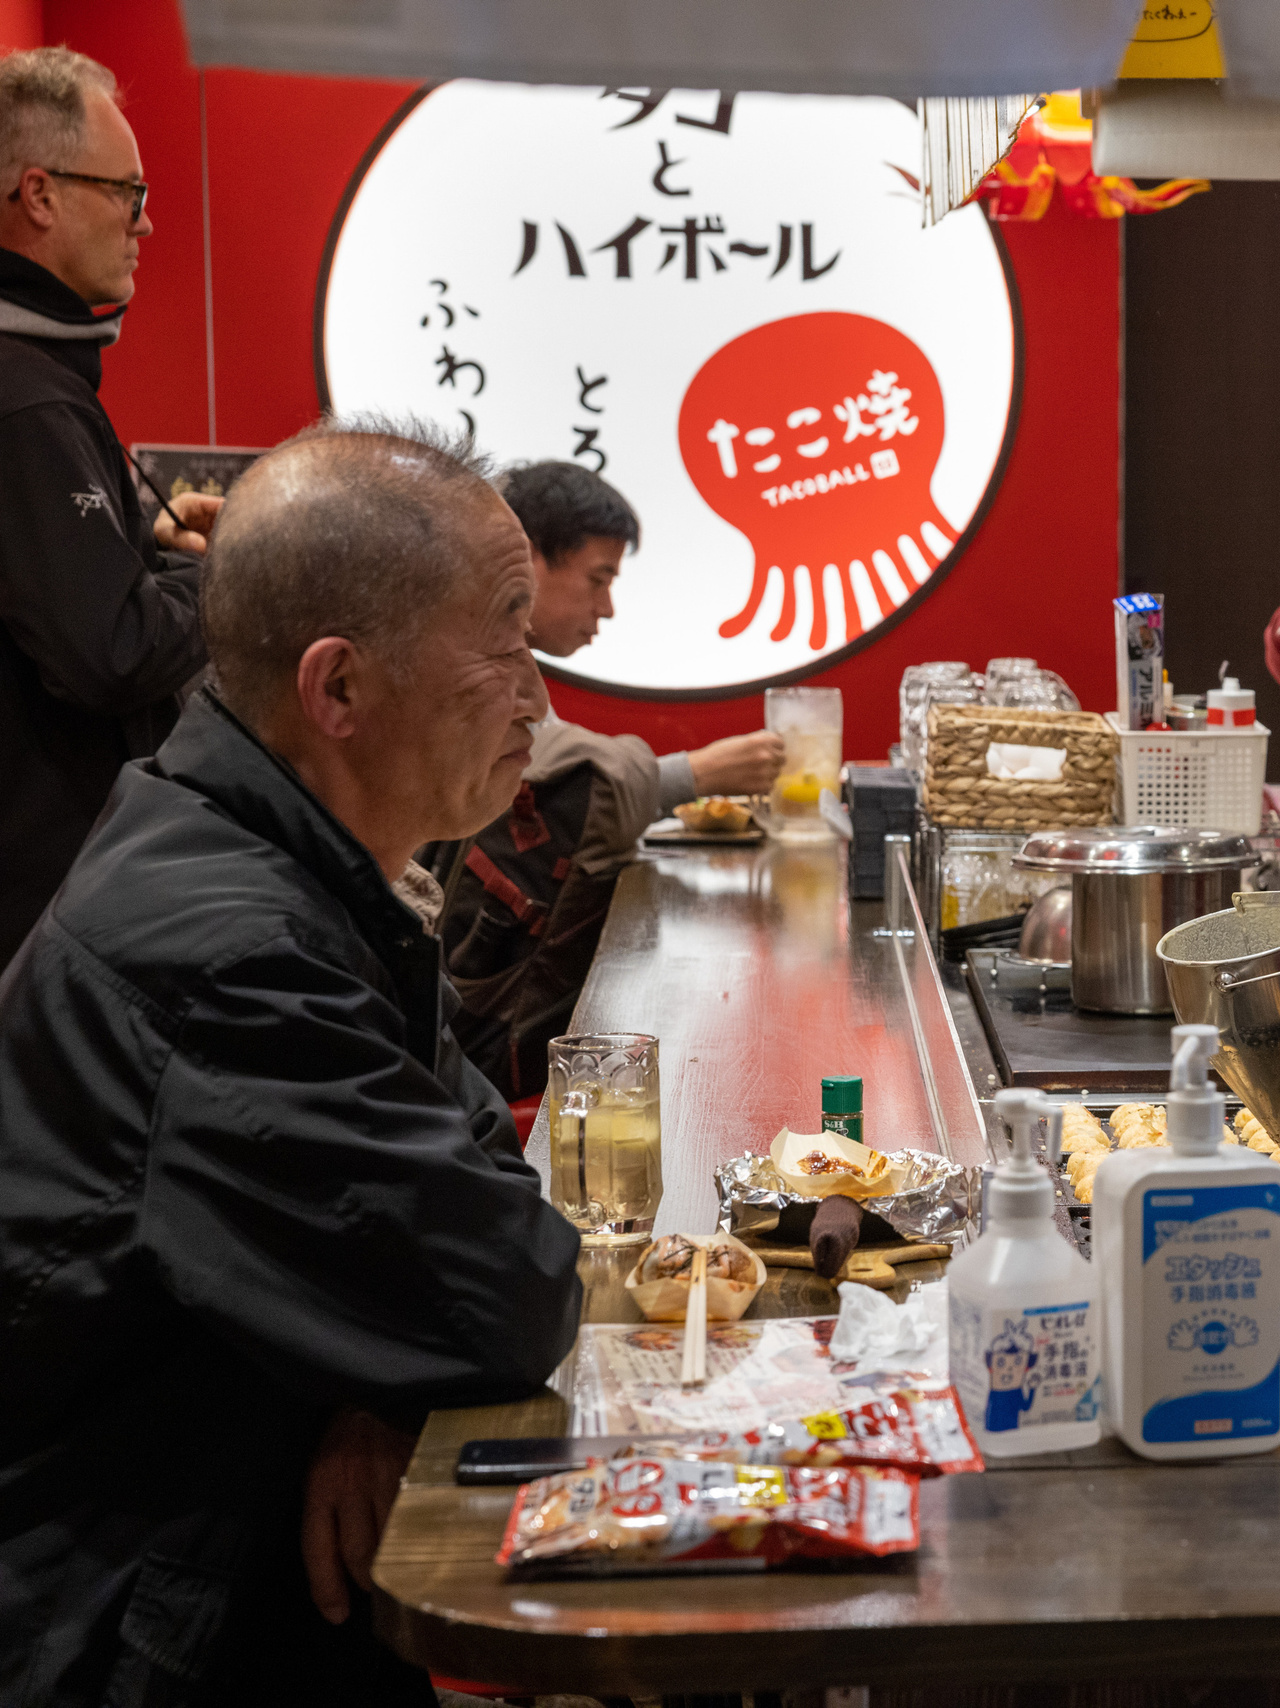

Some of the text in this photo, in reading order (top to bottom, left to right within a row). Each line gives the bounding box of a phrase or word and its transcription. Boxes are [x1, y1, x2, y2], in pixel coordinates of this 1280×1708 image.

[653, 141, 690, 196] と
[706, 369, 919, 479] たこ焼
[760, 462, 871, 507] TACOBALL
[824, 1120, 844, 1129] S&B
